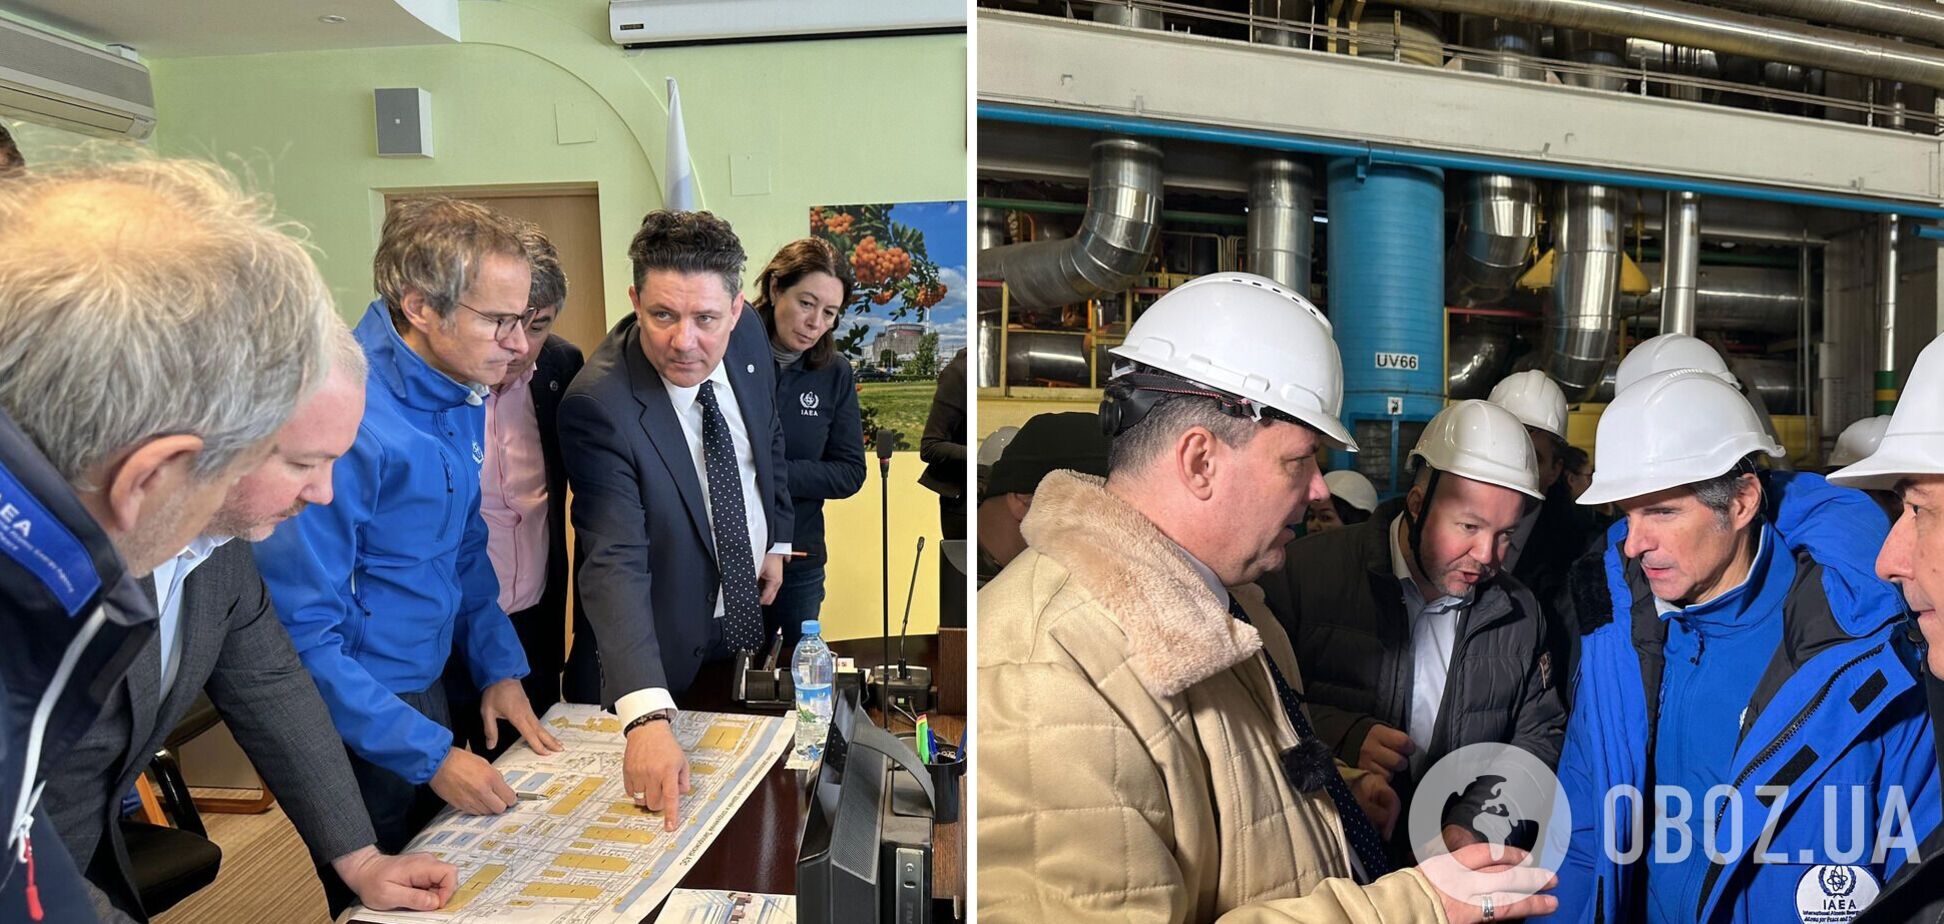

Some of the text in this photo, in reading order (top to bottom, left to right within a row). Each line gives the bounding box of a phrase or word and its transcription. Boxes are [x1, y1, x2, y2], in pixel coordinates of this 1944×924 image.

[1377, 354, 1417, 369] UV66
[0, 493, 32, 538] EA
[1823, 899, 1856, 910] IAEA
